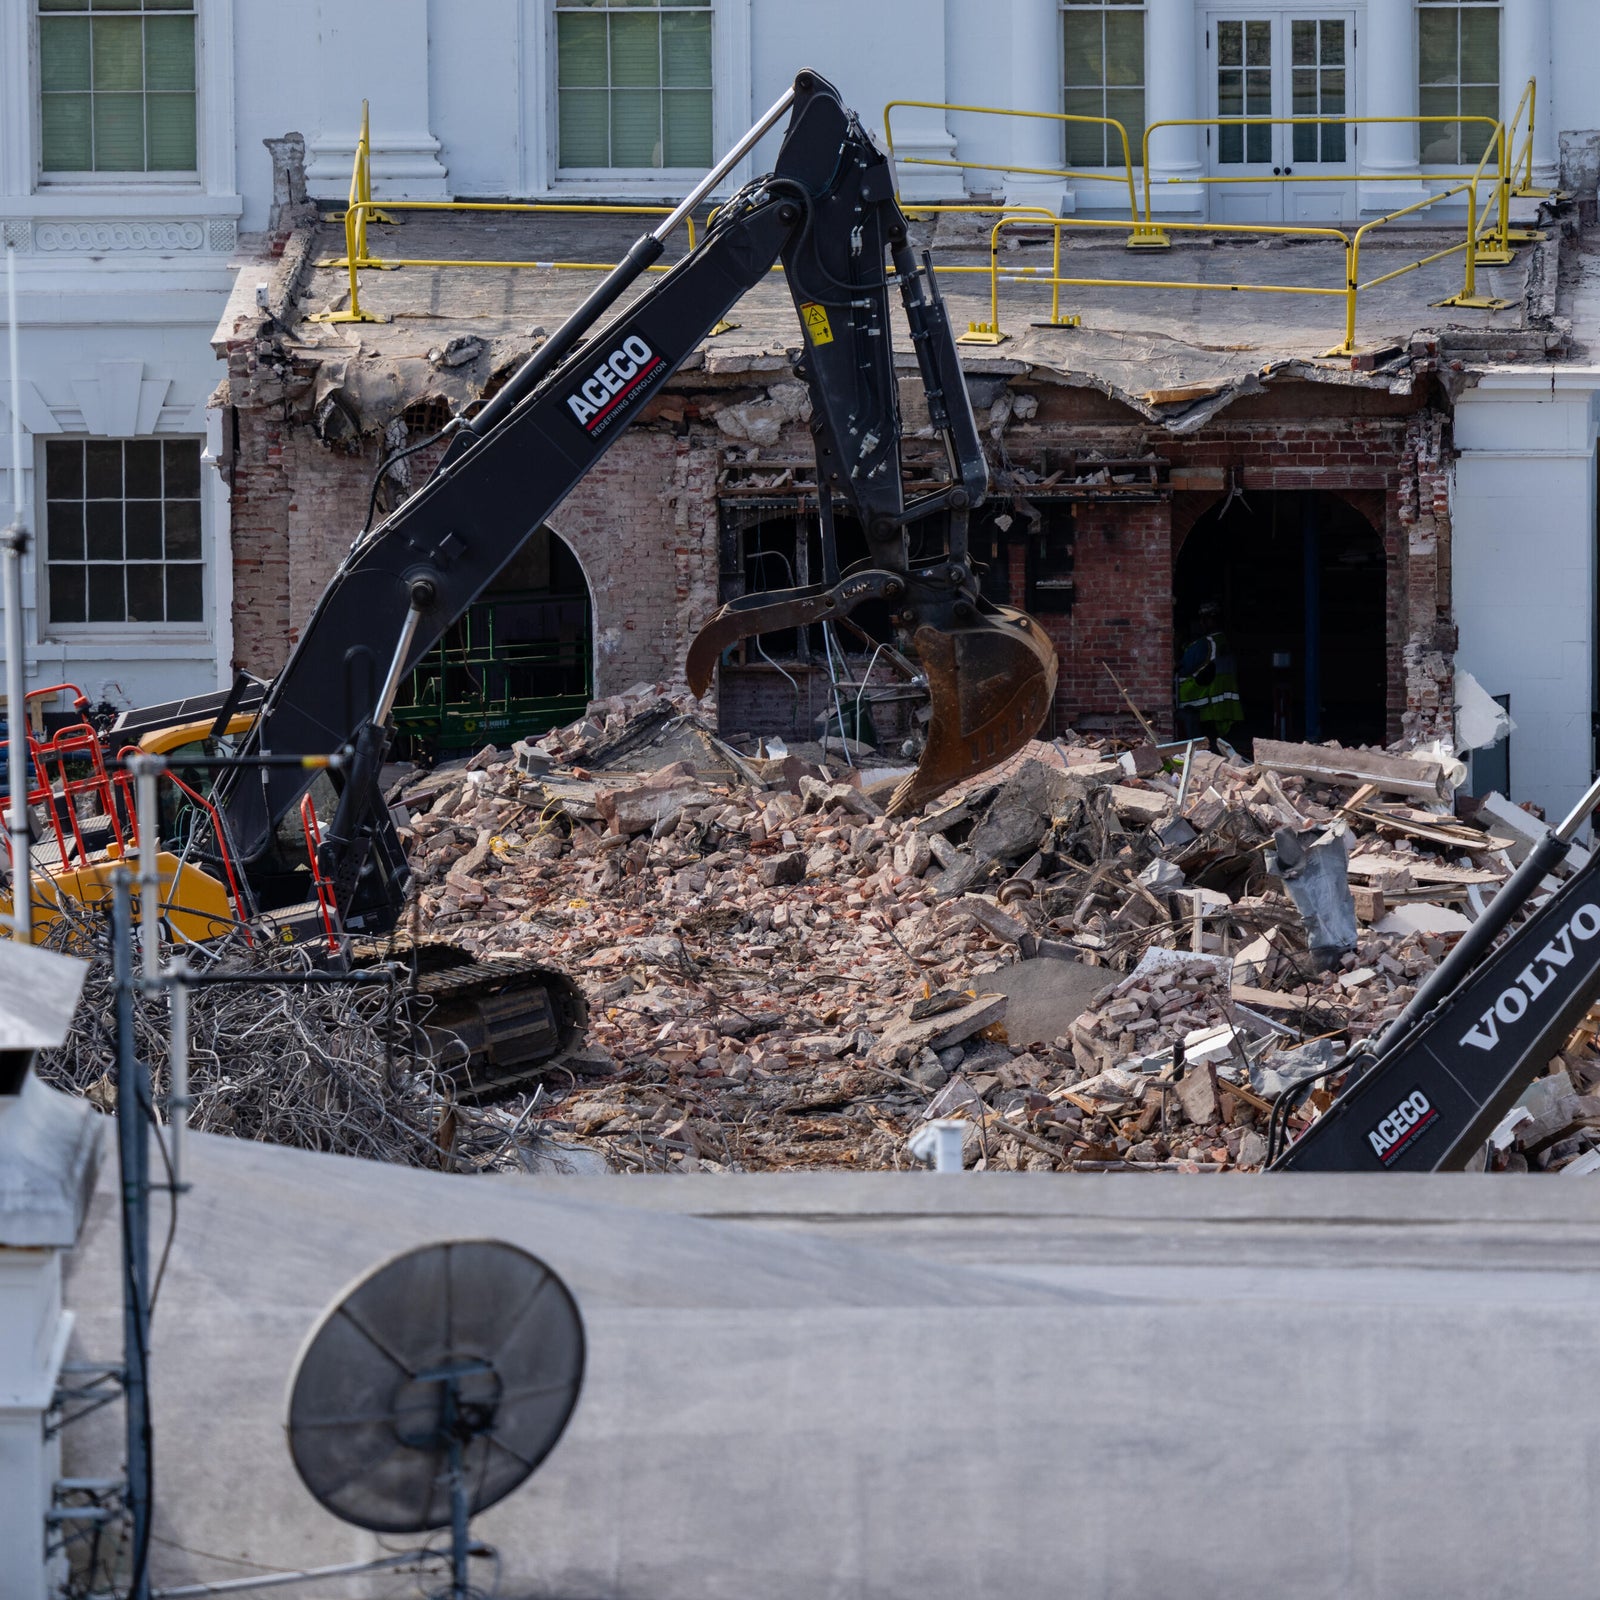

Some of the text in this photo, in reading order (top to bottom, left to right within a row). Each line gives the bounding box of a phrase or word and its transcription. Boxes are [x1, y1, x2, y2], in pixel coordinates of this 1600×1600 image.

[566, 335, 652, 425] ACECO
[591, 360, 668, 437] REDEFINING DEMOLITION
[1458, 903, 1600, 1051] VOLVO
[1368, 1090, 1430, 1157] ACECO
